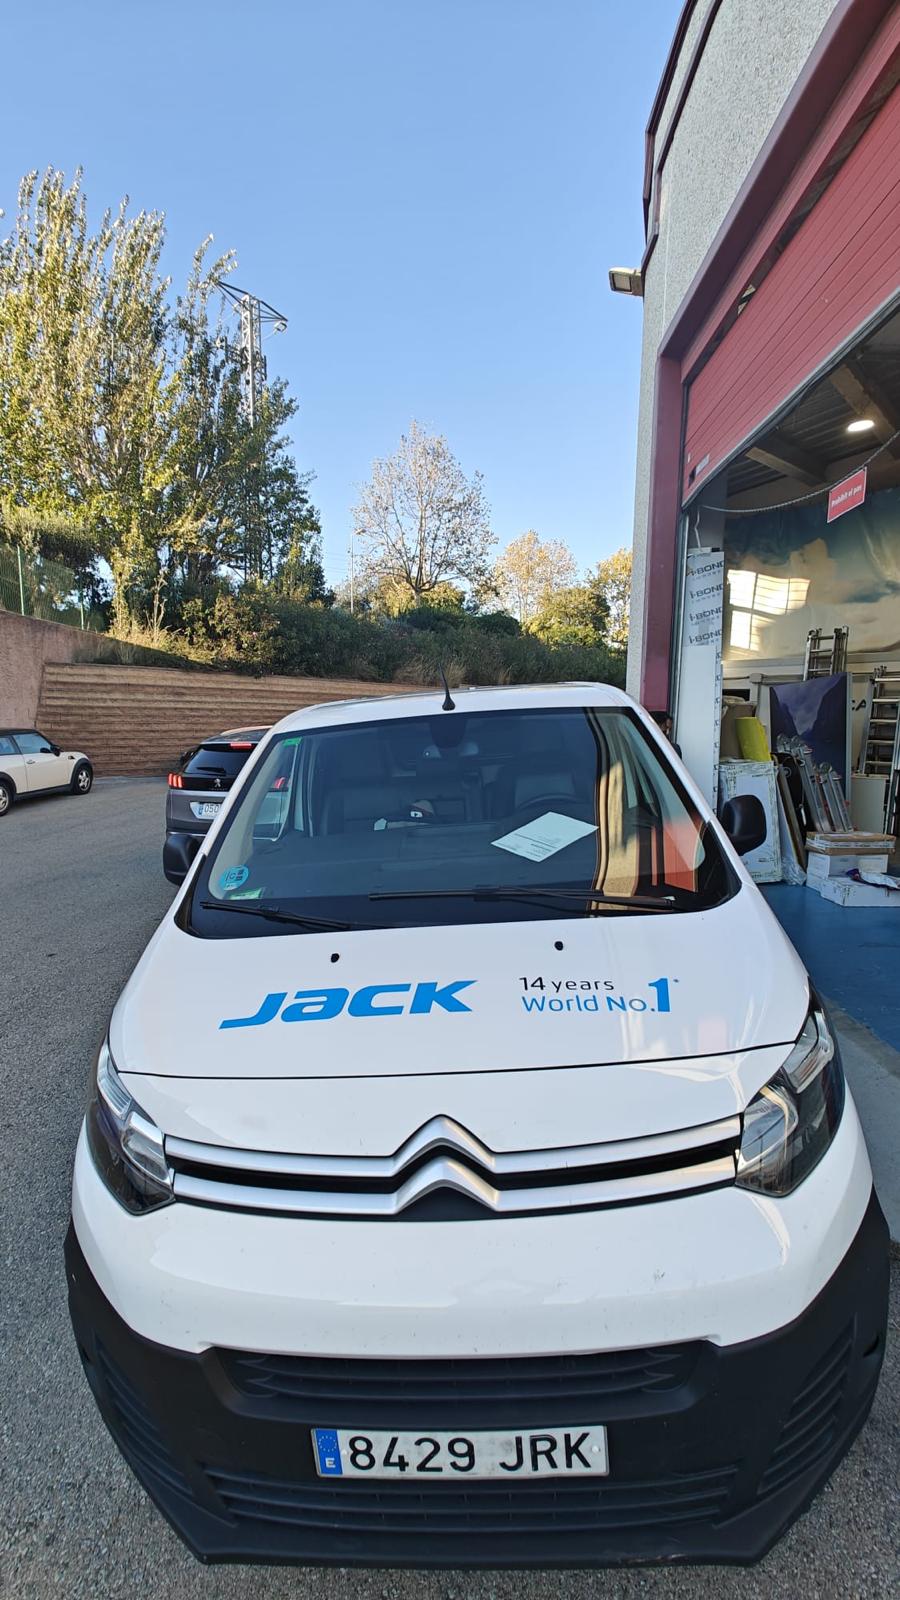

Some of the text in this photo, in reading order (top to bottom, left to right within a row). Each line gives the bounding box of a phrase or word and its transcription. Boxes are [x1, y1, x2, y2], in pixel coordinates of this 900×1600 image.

[519, 976, 615, 993] 14 years
[521, 995, 599, 1012] World
[325, 1432, 592, 1472] E 8429 JRK
